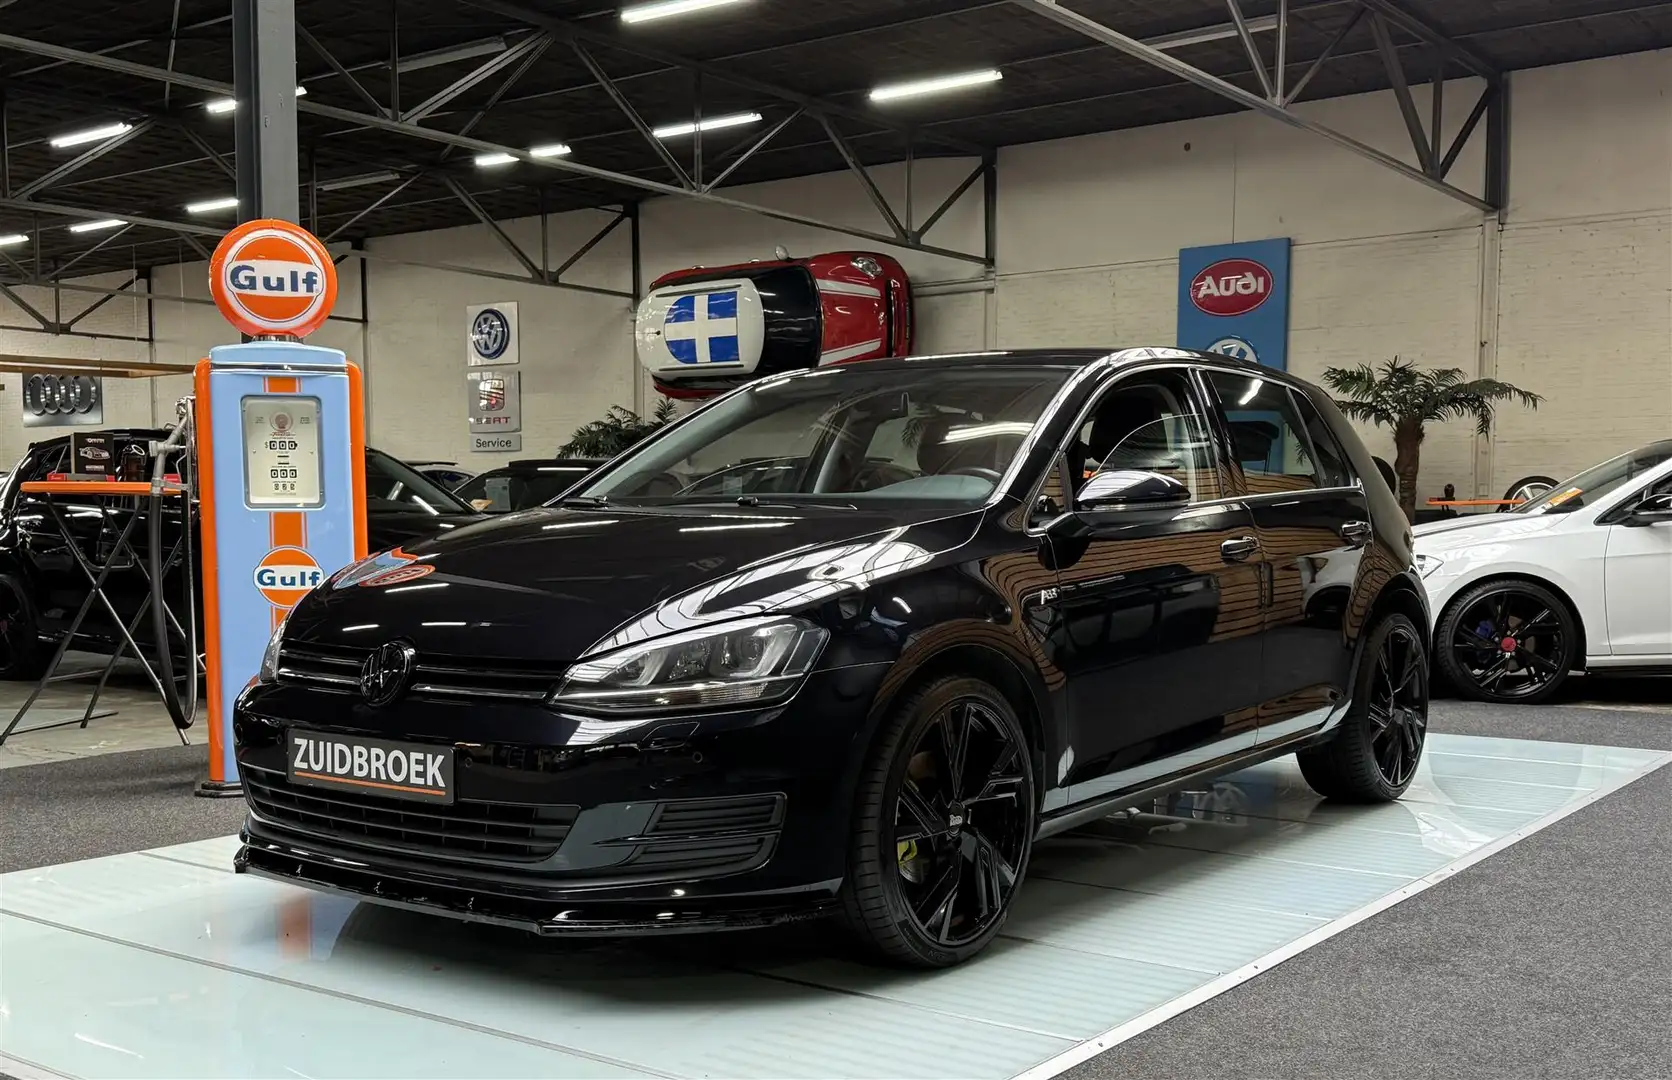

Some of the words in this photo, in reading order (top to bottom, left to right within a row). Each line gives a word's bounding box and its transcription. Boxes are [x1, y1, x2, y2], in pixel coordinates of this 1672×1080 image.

[230, 264, 318, 293] Gulf
[476, 416, 511, 425] SEAT
[476, 437, 512, 448] Service
[257, 569, 320, 587] Gulf
[294, 737, 446, 788] ZUIDBROEK
